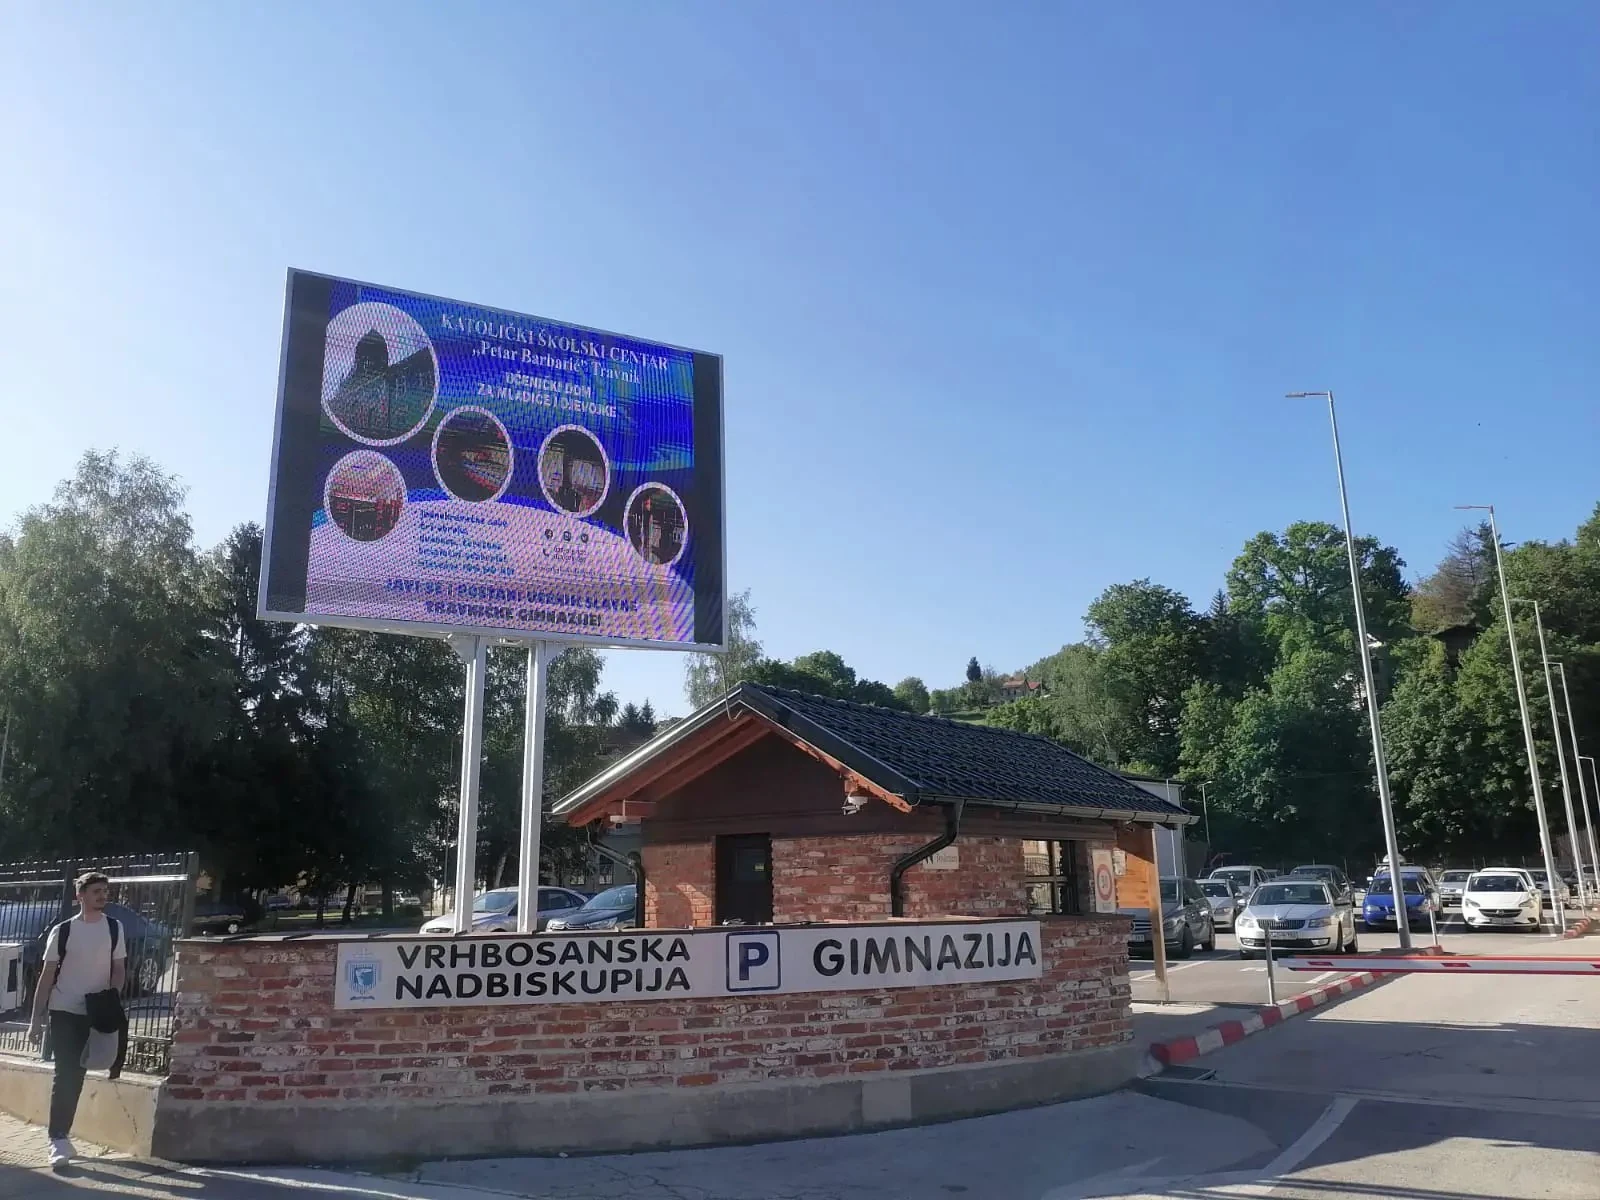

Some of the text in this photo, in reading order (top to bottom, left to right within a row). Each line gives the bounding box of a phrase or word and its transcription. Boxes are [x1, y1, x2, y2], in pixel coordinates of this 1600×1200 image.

[441, 313, 668, 370] KATOLIČKI ŠKOLSKI CENTAR
[591, 360, 640, 384] Travnik
[478, 382, 494, 398] ZA
[560, 397, 617, 418] DJEVOJKE
[565, 382, 591, 398] DOM
[397, 938, 690, 969] VRHBOSANSKA
[738, 942, 769, 981] P
[813, 931, 1036, 977] GIMNAZIJA
[395, 966, 690, 1000] NADBISKUPIJA
